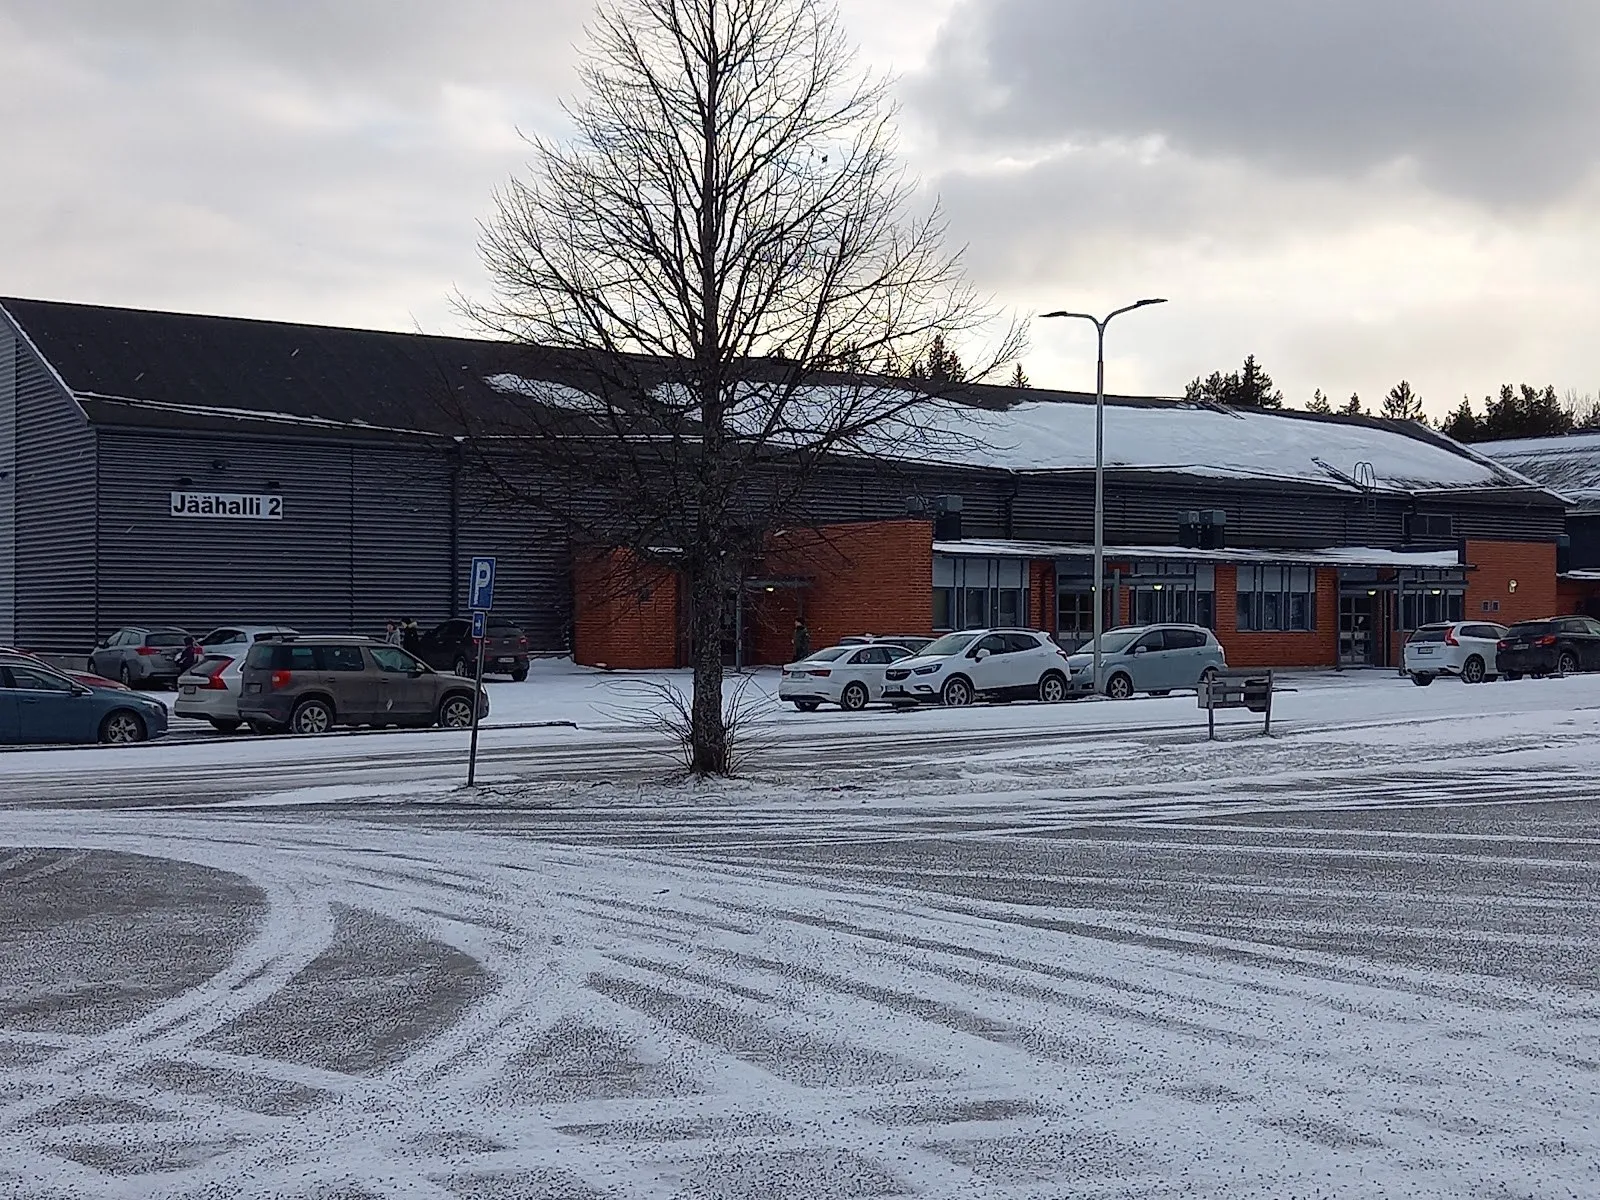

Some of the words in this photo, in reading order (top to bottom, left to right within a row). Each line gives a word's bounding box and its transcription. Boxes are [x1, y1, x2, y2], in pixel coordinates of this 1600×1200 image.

[173, 494, 261, 516] Jäähalli
[268, 497, 281, 516] 2
[473, 561, 491, 605] P
